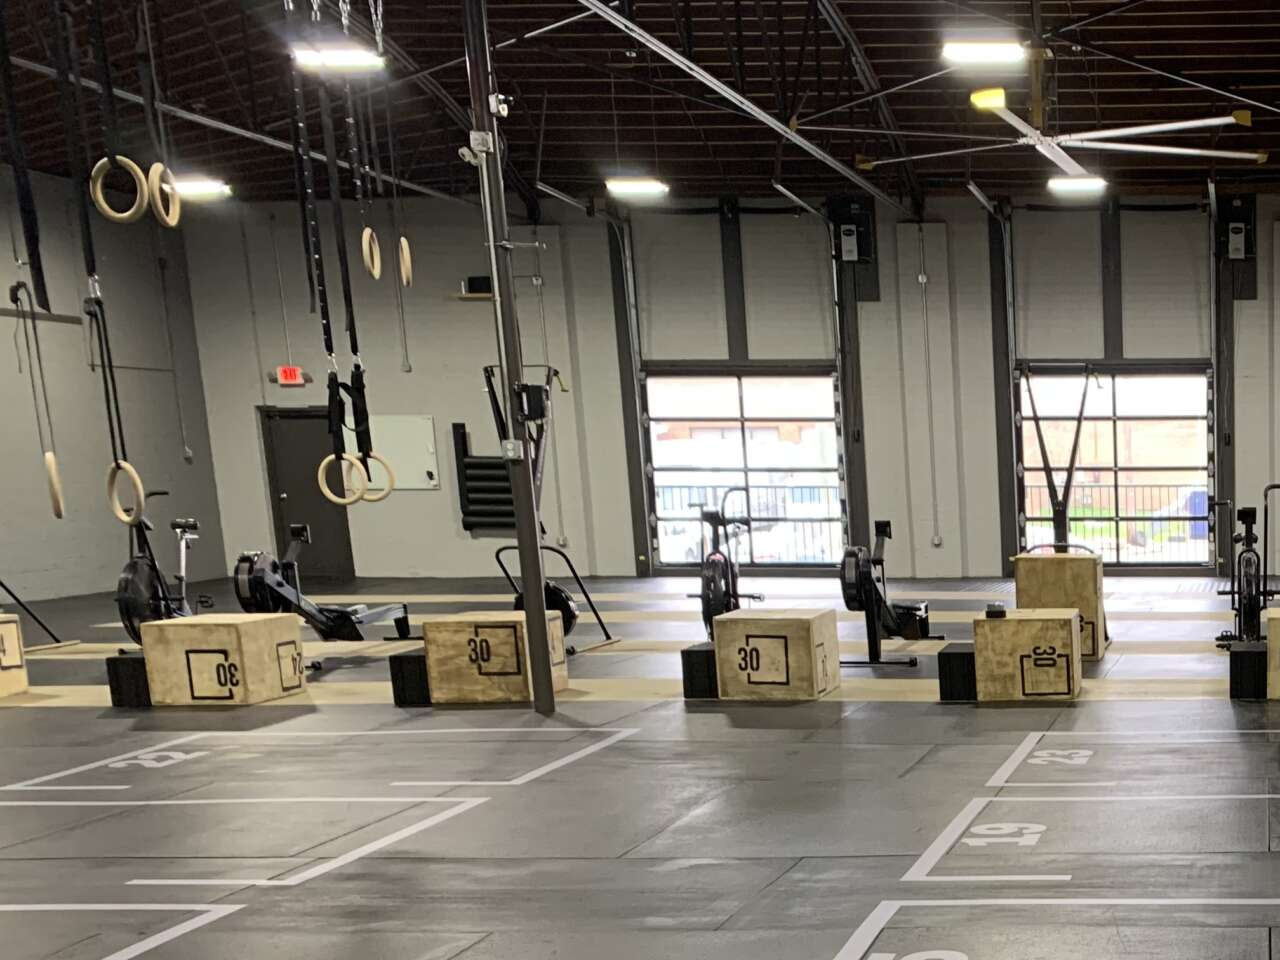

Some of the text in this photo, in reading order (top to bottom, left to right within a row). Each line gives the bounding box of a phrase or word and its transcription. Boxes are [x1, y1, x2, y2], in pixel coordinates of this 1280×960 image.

[468, 638, 491, 663] 30
[738, 647, 760, 671] 30
[1032, 645, 1057, 668] 30
[216, 662, 240, 687] 30
[107, 751, 209, 768] 22
[1026, 749, 1094, 765] 23
[960, 822, 1047, 846] 19
